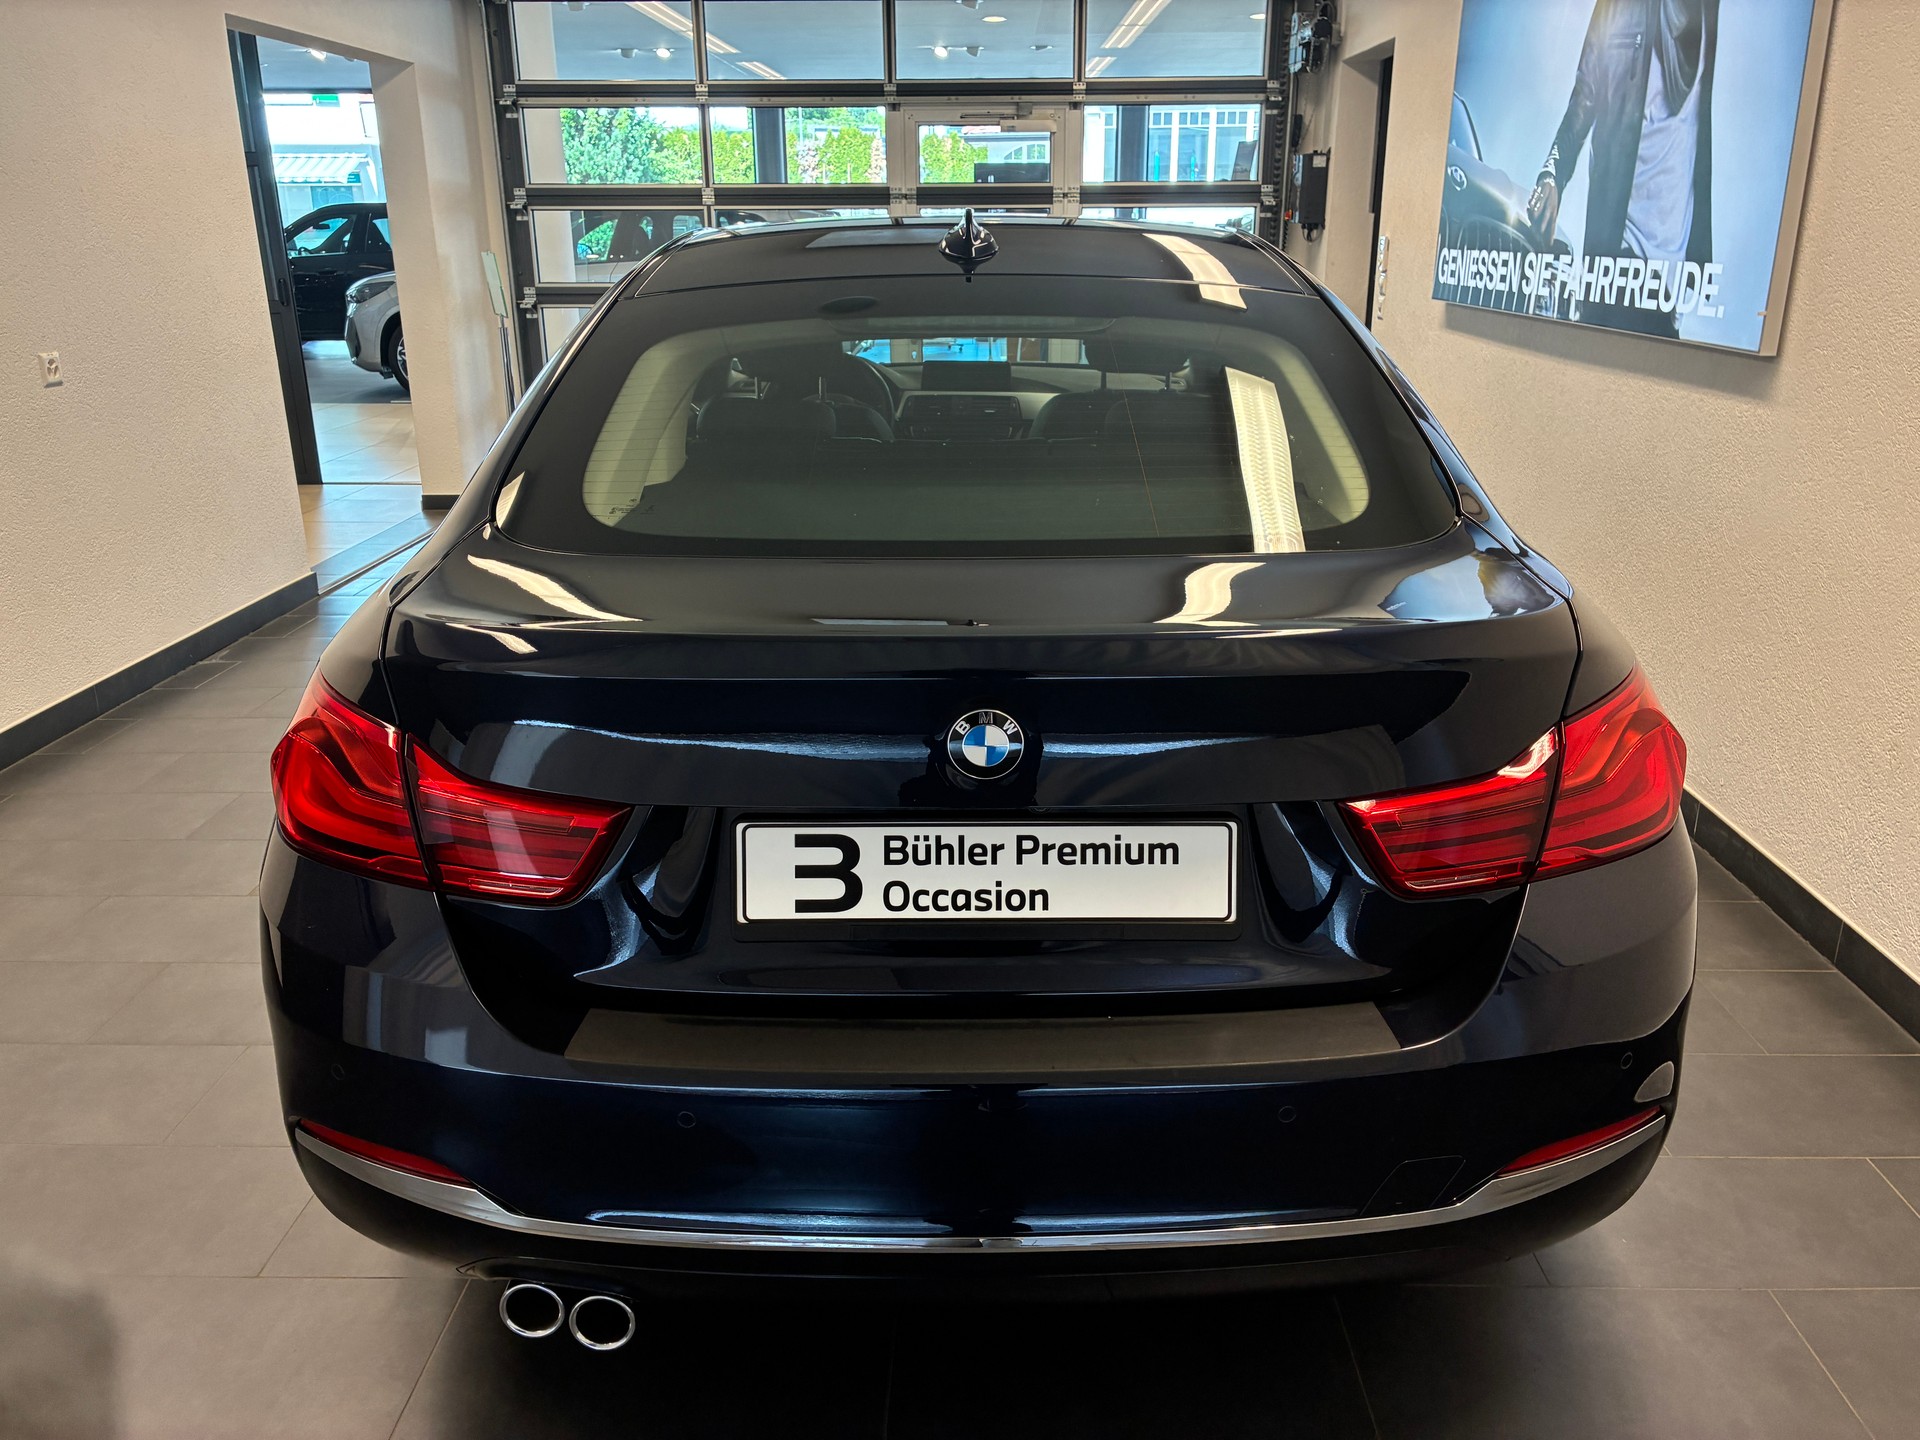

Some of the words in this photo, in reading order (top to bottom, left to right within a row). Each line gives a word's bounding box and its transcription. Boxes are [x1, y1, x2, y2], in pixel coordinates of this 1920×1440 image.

[1438, 248, 1522, 292] GENIESSEN
[1523, 253, 1554, 296] SIE
[1555, 255, 1724, 318] FAHRFREUDE.
[955, 712, 1018, 735] BMW
[883, 834, 1006, 866] Bühler
[1015, 834, 1179, 866] Premium
[882, 881, 1050, 912] Occasion
